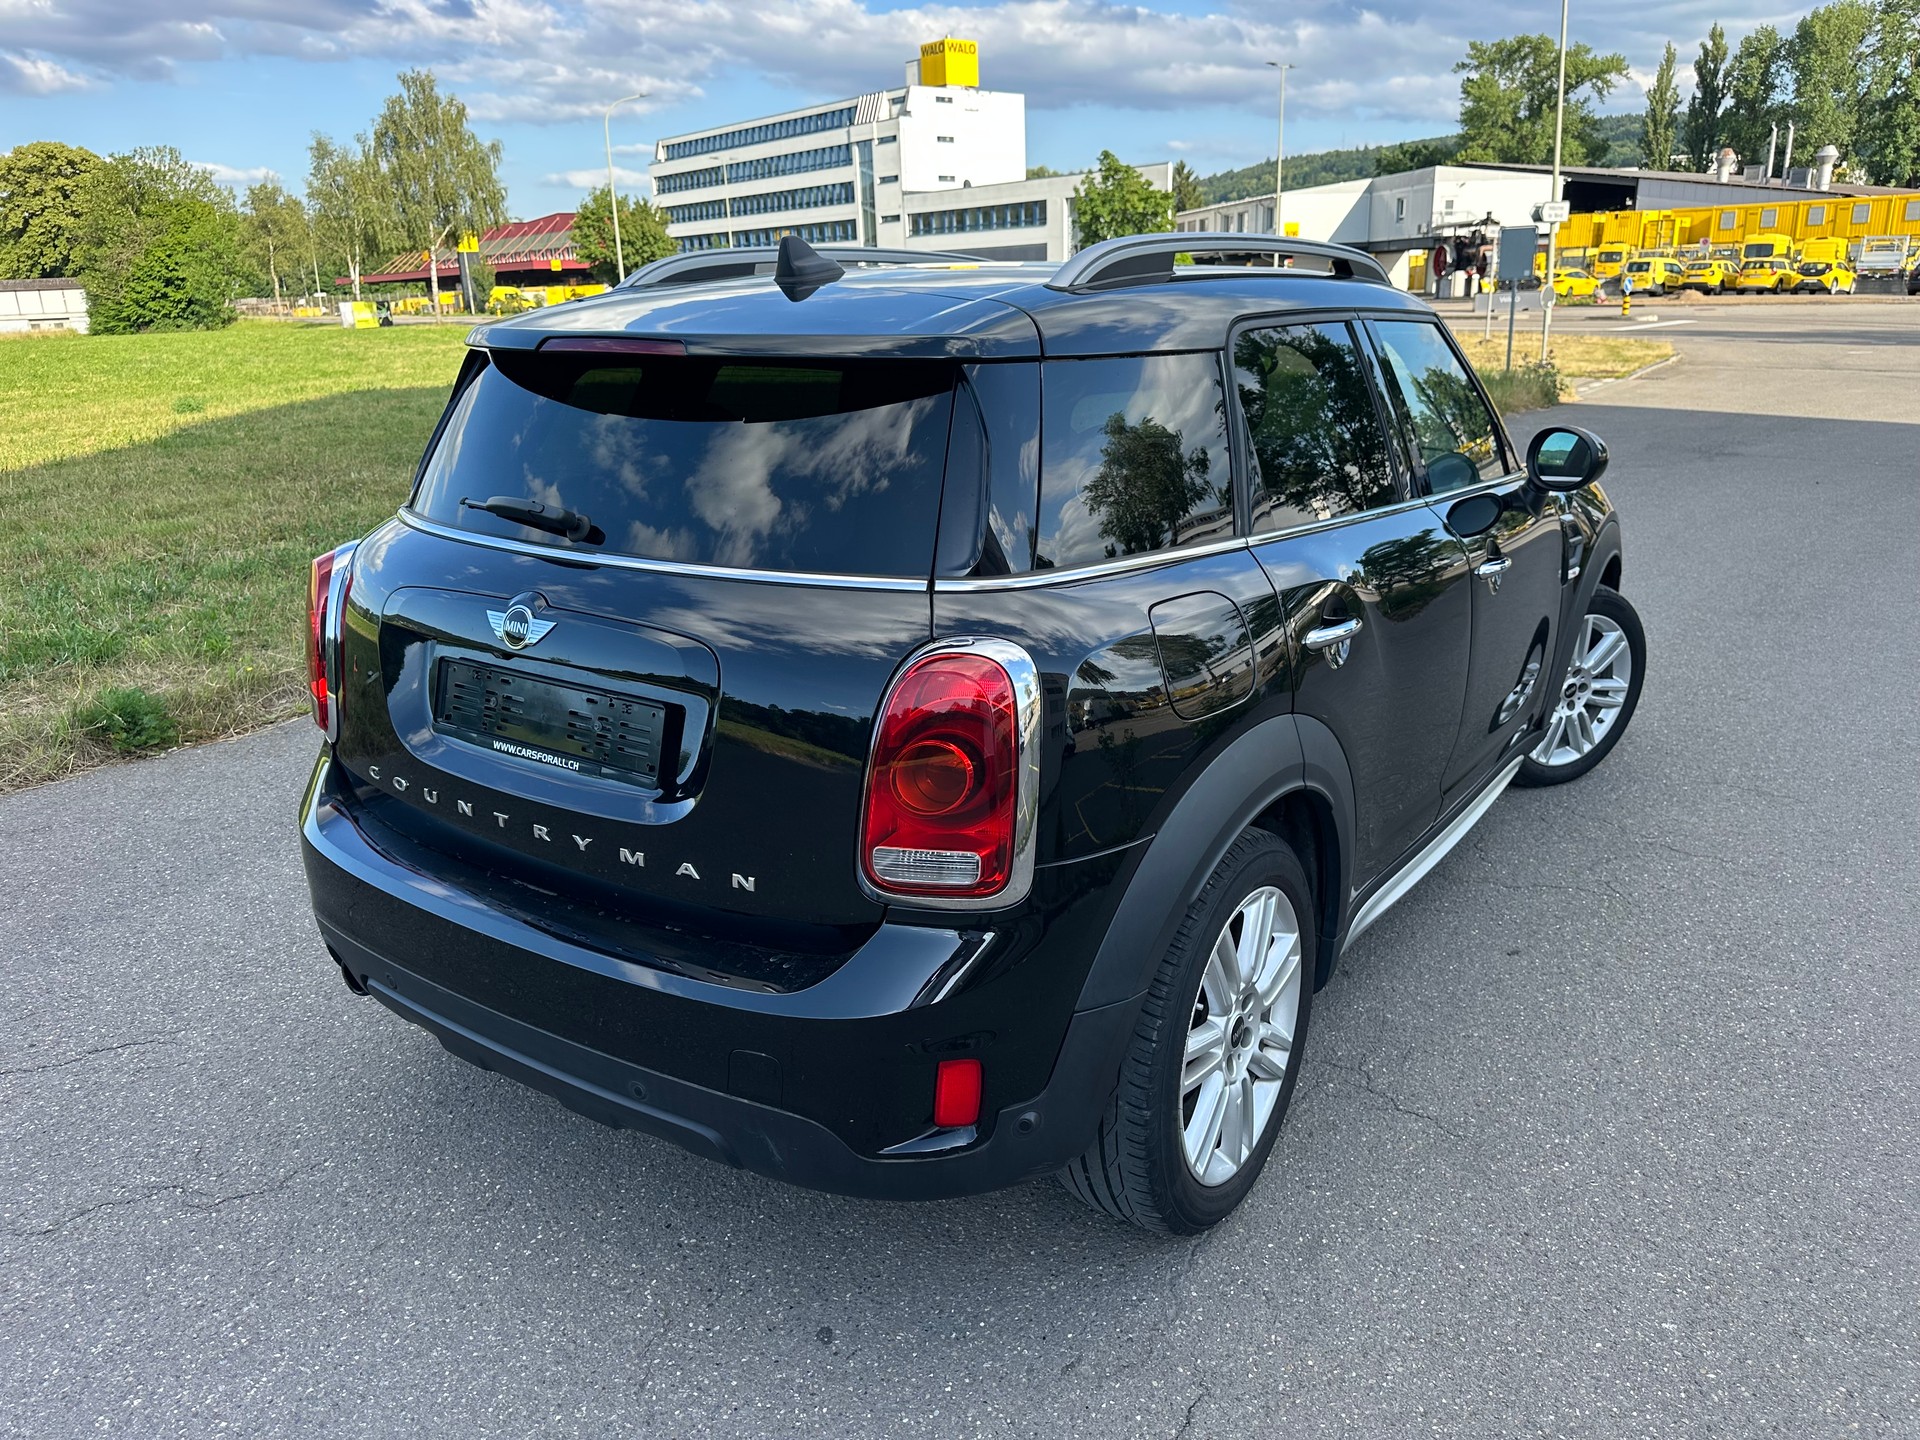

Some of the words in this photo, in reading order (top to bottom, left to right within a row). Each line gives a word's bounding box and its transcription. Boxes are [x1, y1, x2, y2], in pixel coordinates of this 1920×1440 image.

[921, 41, 945, 57] WALO
[947, 42, 976, 55] WALO
[505, 620, 528, 635] MINI
[493, 740, 580, 771] WWW.CARSFORALL.CH
[368, 765, 756, 893] COUNTRYMAN
